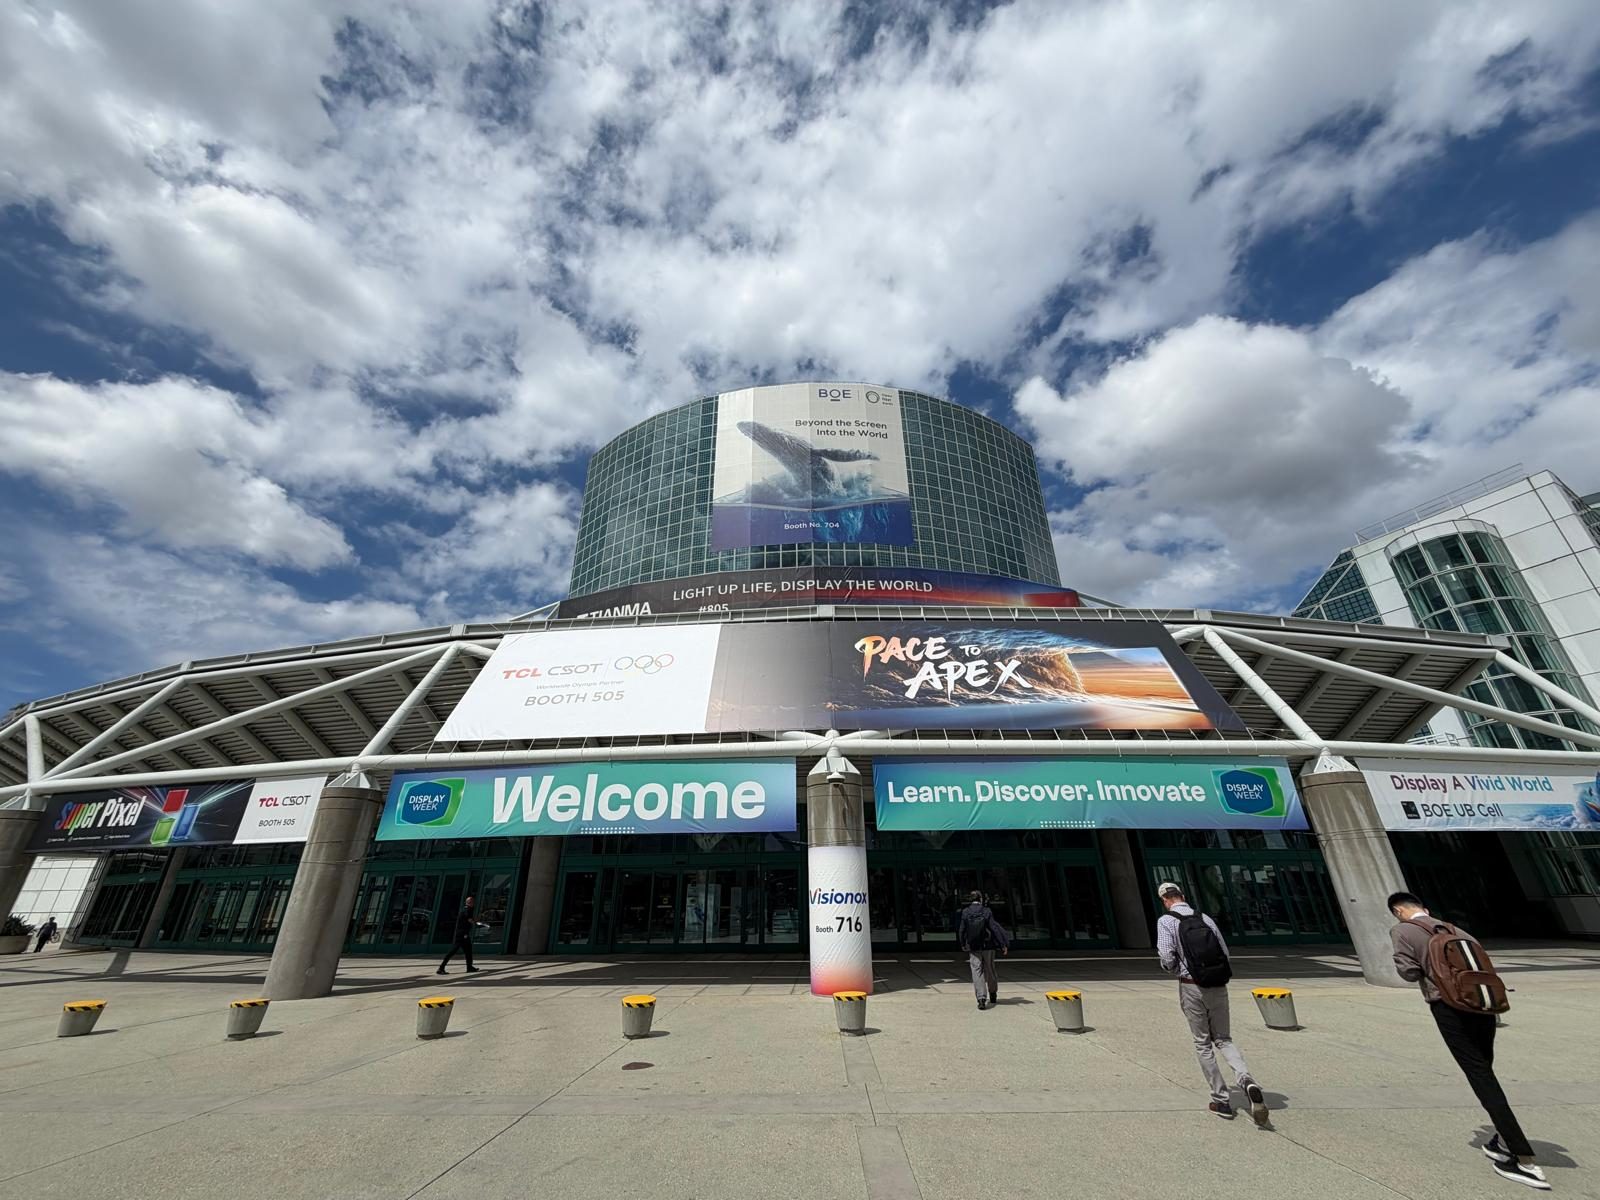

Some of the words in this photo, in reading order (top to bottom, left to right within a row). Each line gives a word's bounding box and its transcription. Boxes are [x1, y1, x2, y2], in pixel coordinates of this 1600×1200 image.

[818, 389, 852, 400] BOE
[795, 419, 833, 428] Beyond
[836, 419, 852, 427] the
[854, 420, 888, 430] Screen
[816, 429, 837, 437] Into
[839, 429, 856, 437] the
[858, 429, 888, 440] World
[784, 522, 808, 530] Booth
[809, 521, 822, 529] No.
[824, 521, 840, 529] 704
[672, 586, 715, 601] LIGHT
[718, 584, 739, 595] UP
[742, 582, 777, 594] LIFE,
[781, 580, 842, 592] DISPLAY
[846, 580, 876, 591] THE
[879, 580, 933, 592] WORLD
[854, 635, 952, 682] PACE
[959, 644, 982, 657] TO
[502, 668, 542, 679] TCL
[547, 663, 603, 676] CSOT
[903, 659, 1034, 701] APEX
[524, 692, 588, 707] BOOTH
[591, 690, 625, 702] 505
[1226, 783, 1264, 793] DISPLAY
[1389, 774, 1448, 793] Display
[1452, 775, 1466, 791] A
[1464, 775, 1506, 792] Vivid
[1504, 775, 1554, 792] World
[408, 794, 446, 804] DISPLAY
[492, 773, 766, 824] Welcome
[887, 781, 971, 803] Learn.
[975, 780, 1094, 802] Discover.
[1096, 780, 1207, 802] Innovate
[1233, 791, 1263, 800] WEEK
[258, 797, 280, 808] TCL
[281, 795, 312, 807] CSOT
[412, 802, 438, 811] WEEK
[54, 801, 105, 836] Super
[97, 795, 147, 828] Pixel
[1420, 803, 1451, 818] BOE
[1453, 803, 1477, 817] UB
[1477, 803, 1504, 817] Cell
[258, 819, 281, 827] BOOTH
[282, 818, 296, 826] 505
[810, 887, 867, 905] Visionox
[815, 925, 834, 933] Booth
[835, 916, 863, 933] 716
